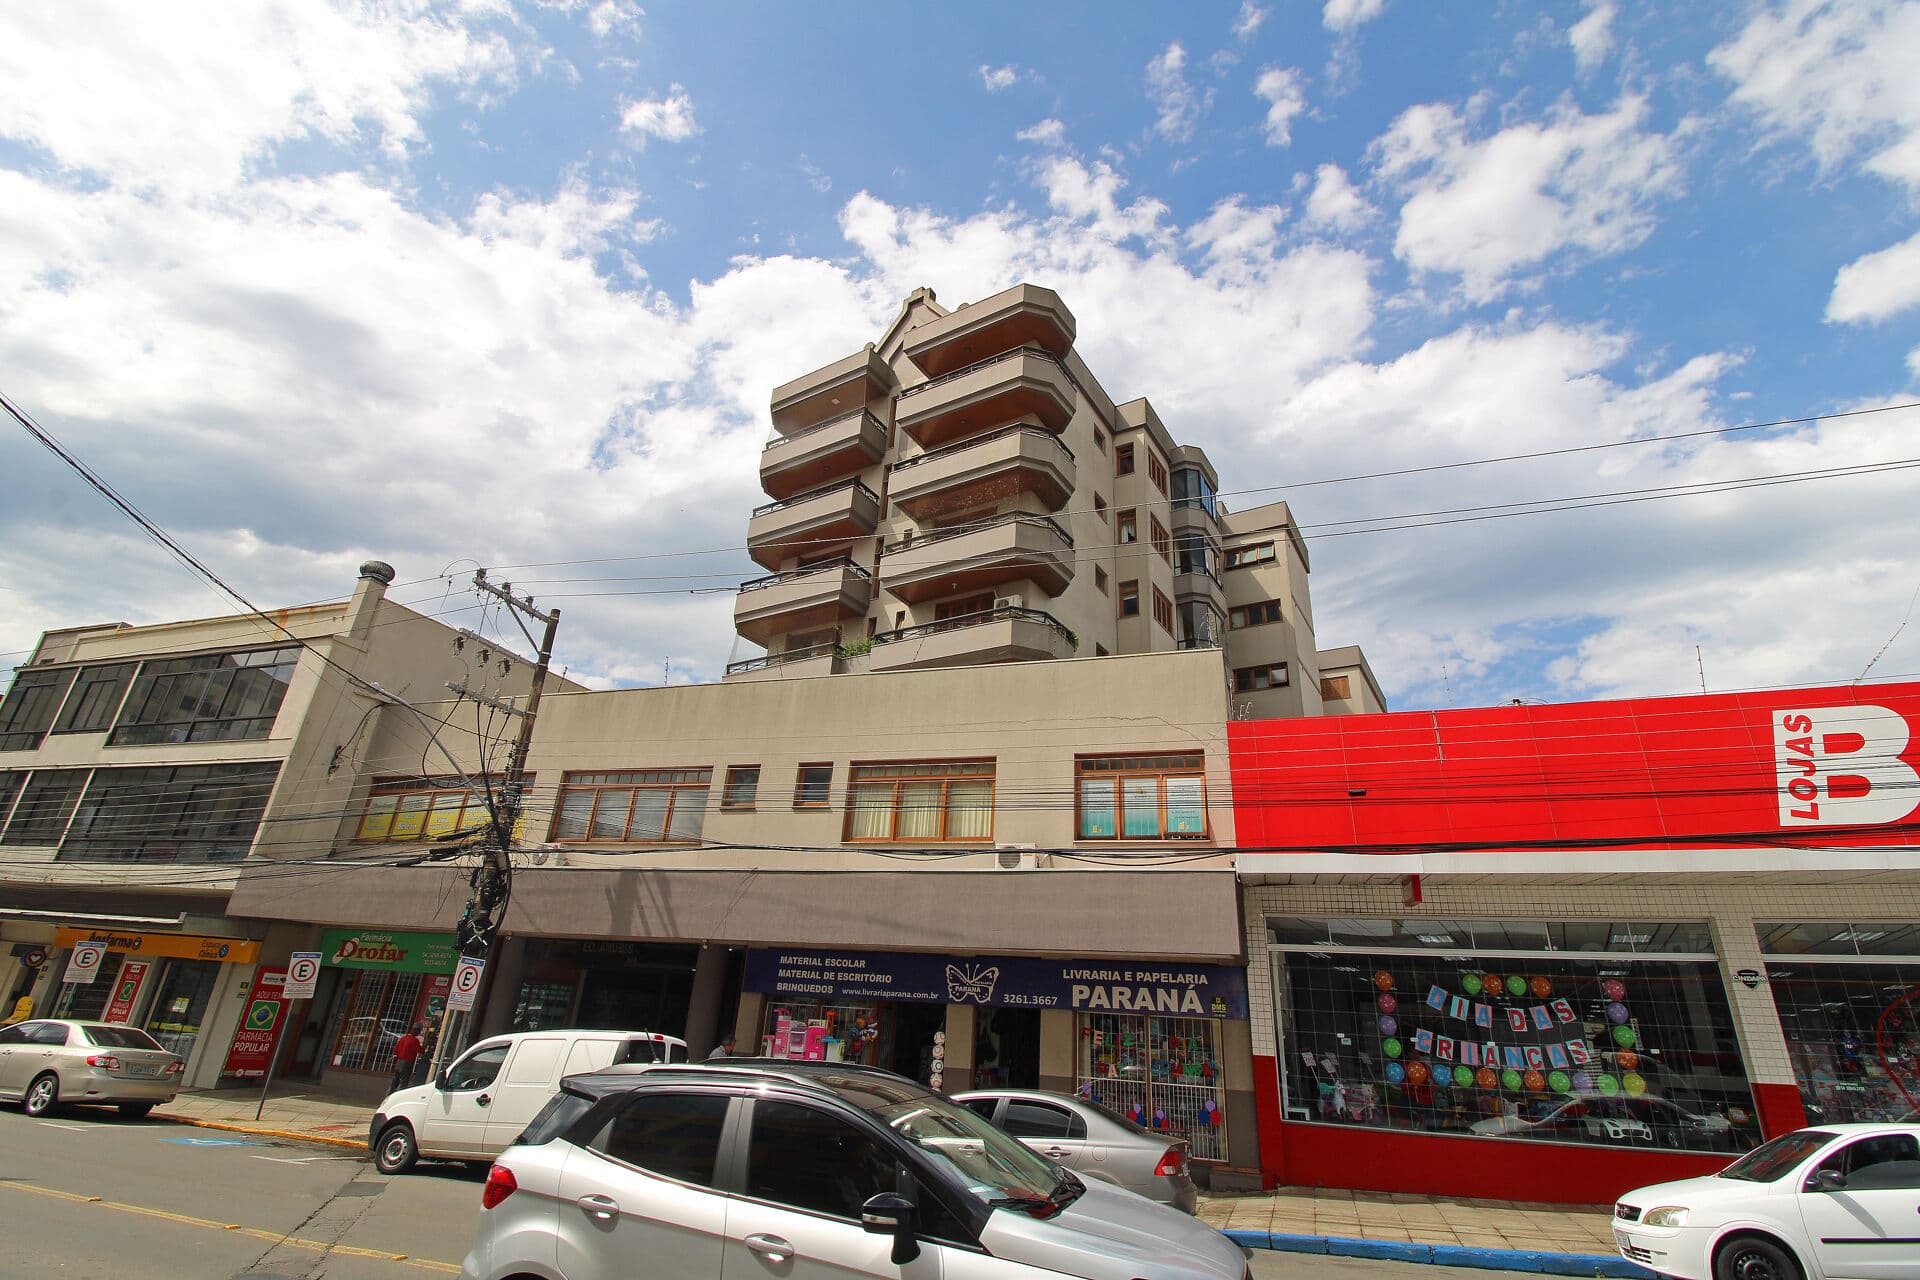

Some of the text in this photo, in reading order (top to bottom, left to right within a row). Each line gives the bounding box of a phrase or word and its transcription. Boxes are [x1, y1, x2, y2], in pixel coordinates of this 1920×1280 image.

[1783, 713, 1820, 822] LOJAS
[80, 952, 93, 964] E
[336, 940, 408, 962] Drofar
[297, 964, 310, 977] E
[780, 956, 866, 969] MATERIAL ESCOLAR
[461, 971, 473, 987] E
[778, 969, 893, 983] MATERIAL DE ESCRITÓRIO
[1062, 969, 1209, 985] LIVRARIA E PAPELARIA
[776, 983, 939, 1000] BRINQUEDOS www.livrariaparana.com.br
[1072, 983, 1205, 1014] PARANÁ
[1003, 993, 1058, 1007] 3261.3667
[1428, 986, 1577, 1031] DIA DAS
[233, 1042, 270, 1052] POPULAR
